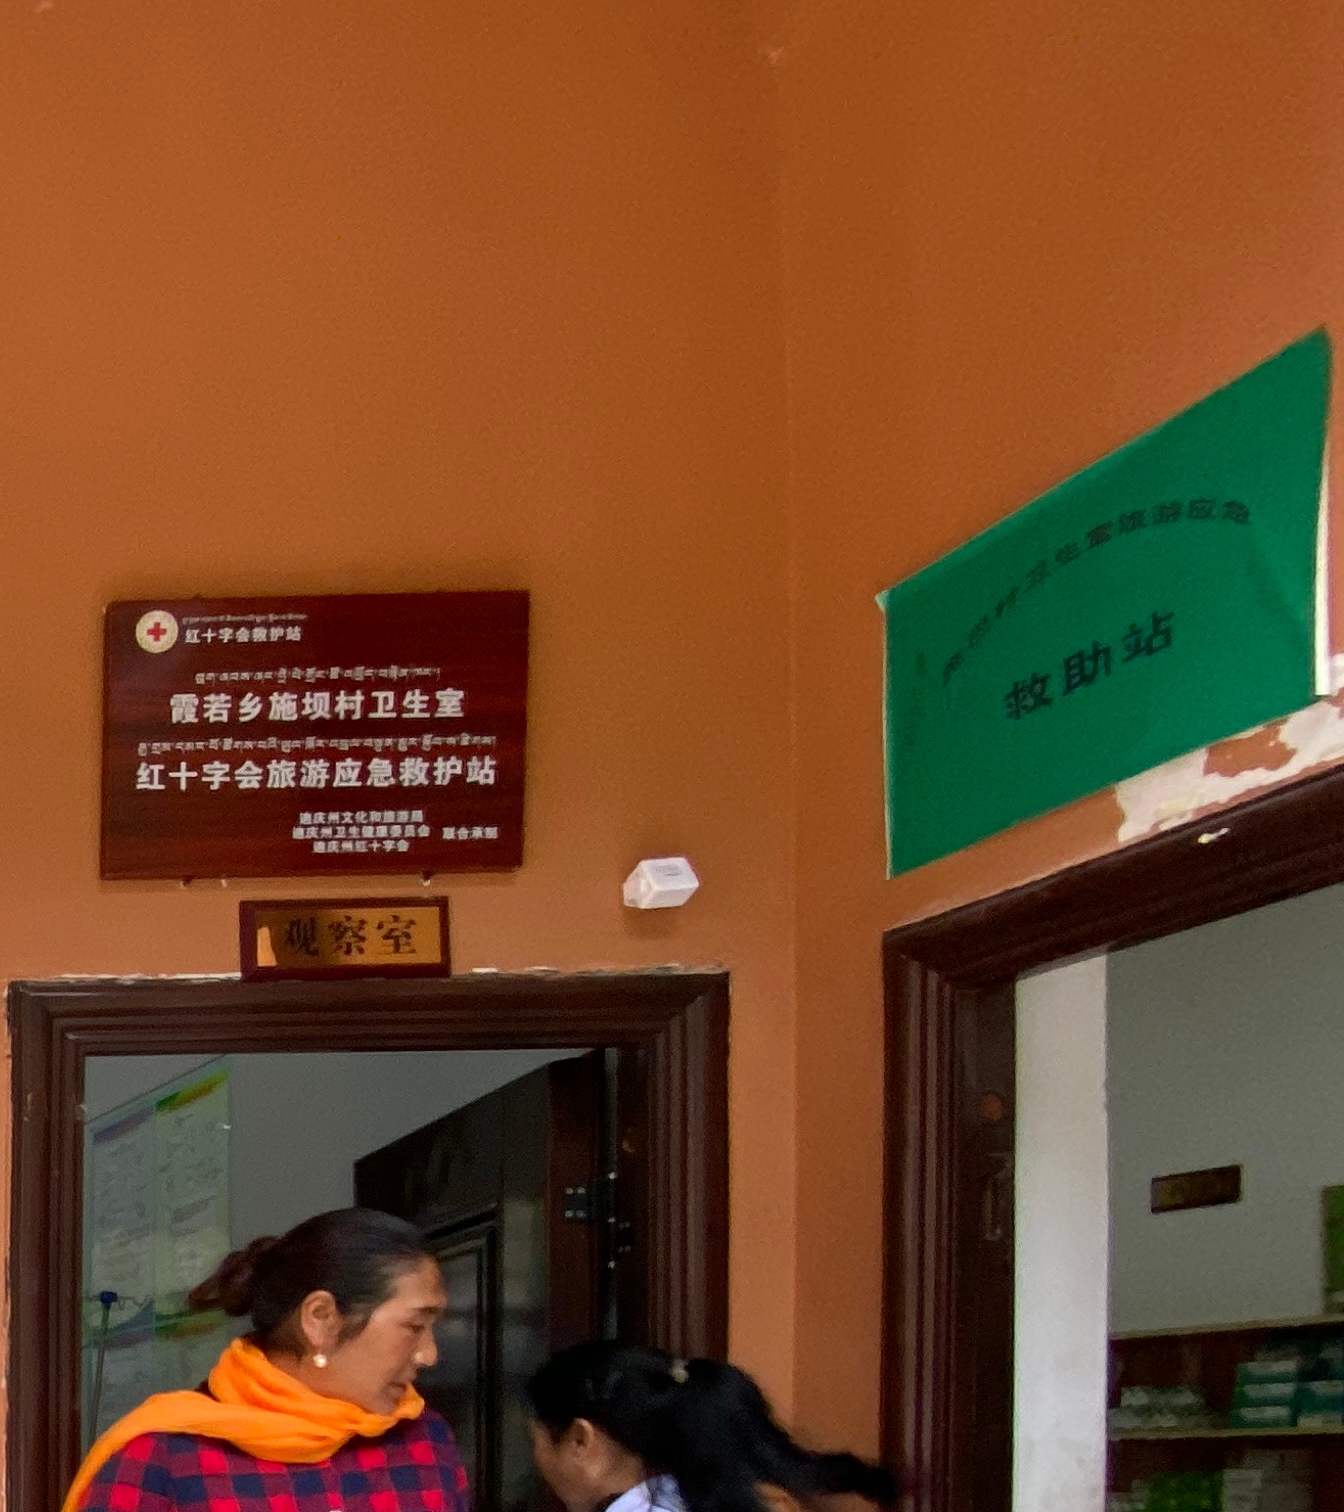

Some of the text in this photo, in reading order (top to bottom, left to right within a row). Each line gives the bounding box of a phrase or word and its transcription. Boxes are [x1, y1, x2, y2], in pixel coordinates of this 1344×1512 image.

[184, 625, 302, 644] 红十字会救护站
[1002, 609, 1175, 720] 救助站
[169, 688, 465, 724] 霞若乡施坝村卫生室
[135, 754, 497, 792] 红十字会旅游应急救护站
[284, 914, 418, 957] 观察室
